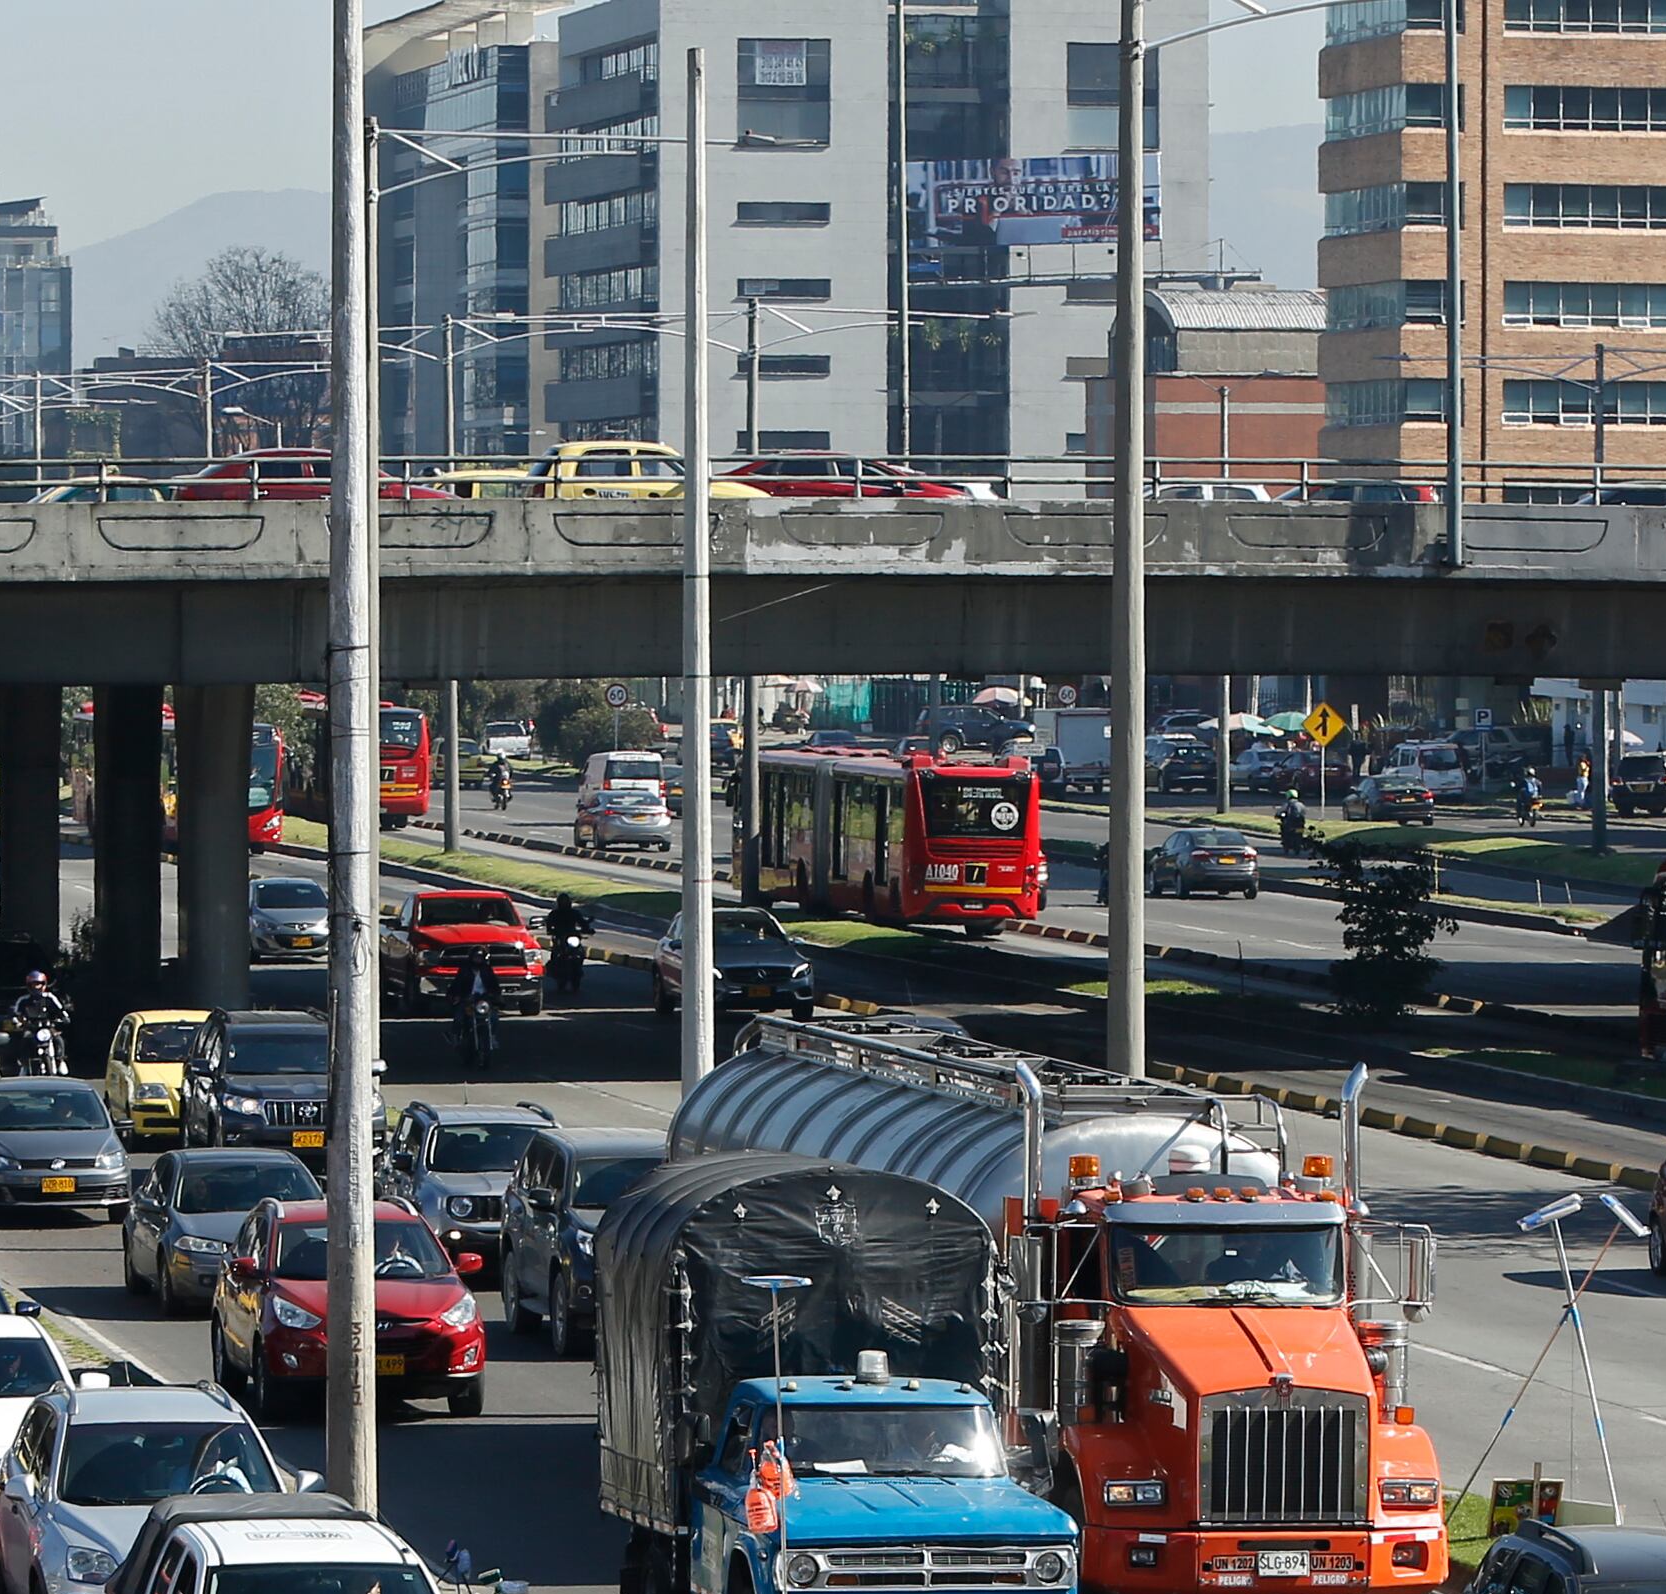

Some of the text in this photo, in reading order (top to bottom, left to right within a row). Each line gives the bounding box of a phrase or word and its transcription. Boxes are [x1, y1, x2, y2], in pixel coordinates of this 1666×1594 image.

[1011, 184, 1033, 195] QUE
[1039, 184, 1055, 194] NO
[1060, 183, 1090, 194] ERES
[1096, 182, 1111, 193] LA
[947, 193, 1111, 213] PRORIDAD?
[609, 689, 624, 701] 60
[1061, 689, 1073, 701] 60
[925, 863, 959, 878] A1040
[1214, 1557, 1255, 1570] UN 1202
[1310, 1556, 1352, 1569] UN 1203
[1217, 1574, 1253, 1586] PELIGRO
[1313, 1574, 1347, 1585] PELIGRO
